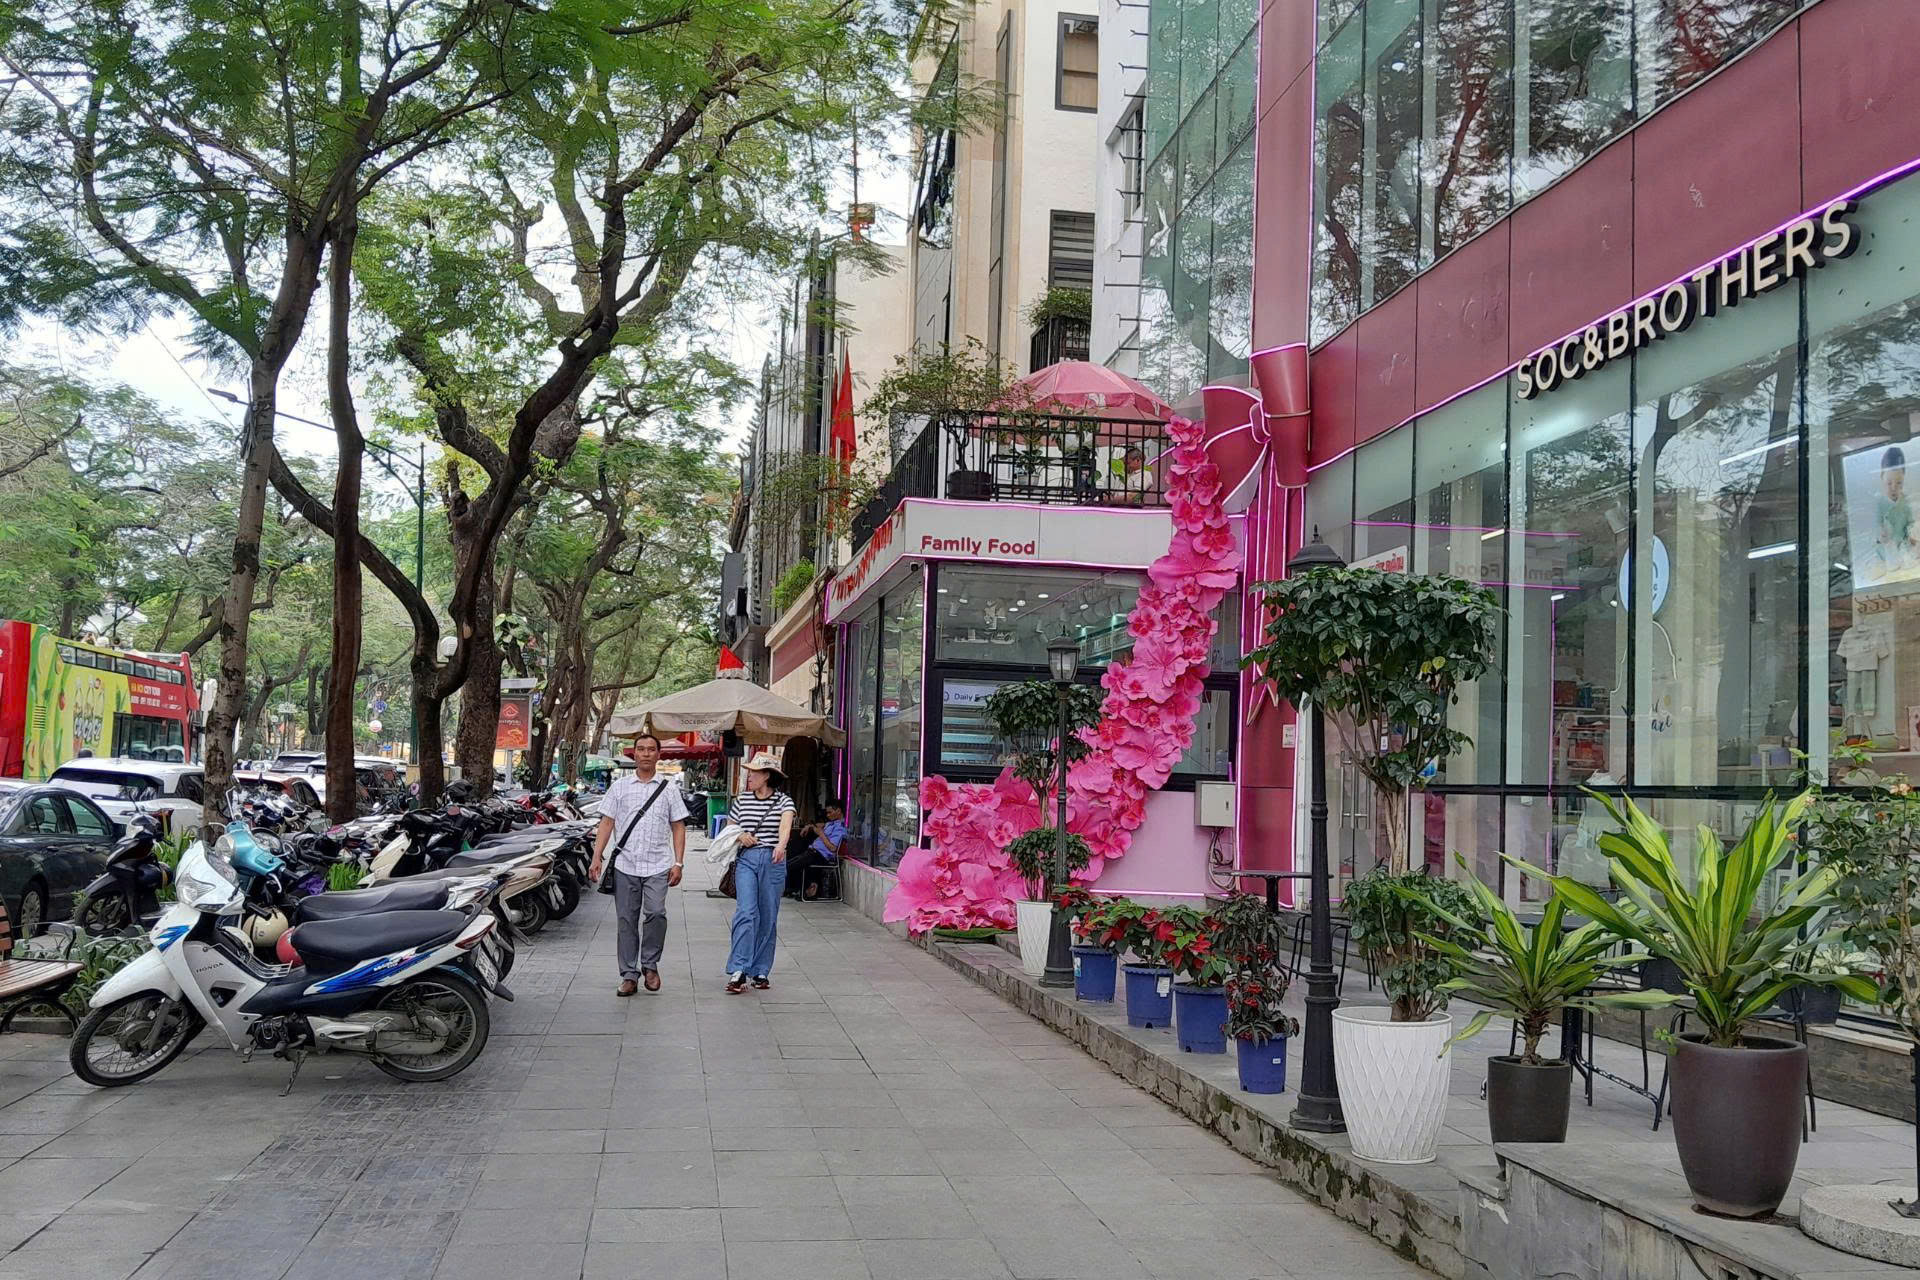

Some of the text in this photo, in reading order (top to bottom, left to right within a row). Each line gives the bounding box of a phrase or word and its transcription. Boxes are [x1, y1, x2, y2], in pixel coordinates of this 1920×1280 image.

[1516, 199, 1857, 399] SOC&BROTHERS
[988, 538, 1035, 555] Food
[196, 962, 224, 973] HONDA
